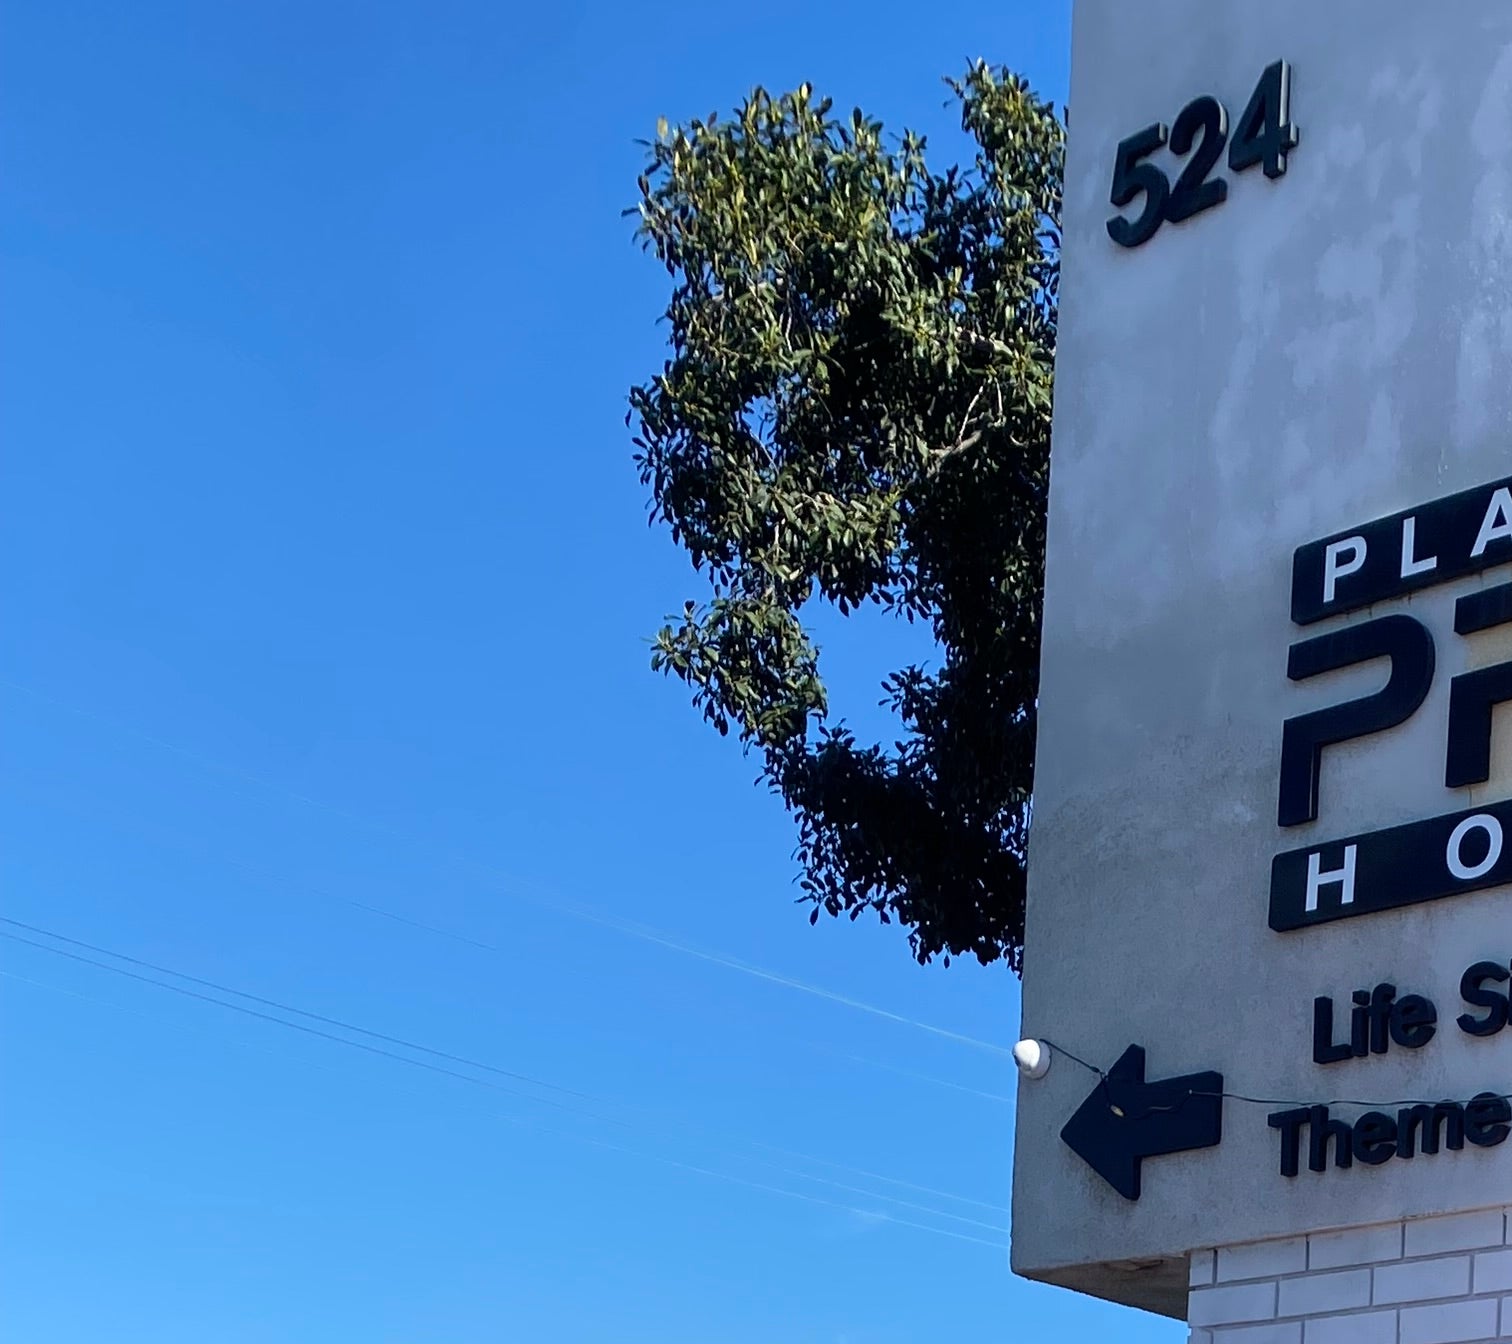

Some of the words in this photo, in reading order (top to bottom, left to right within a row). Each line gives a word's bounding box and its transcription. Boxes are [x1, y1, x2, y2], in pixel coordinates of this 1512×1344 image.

[1106, 58, 1299, 248] 524
[1312, 981, 1436, 1066] Life
[1268, 1091, 1512, 1178] Theme
